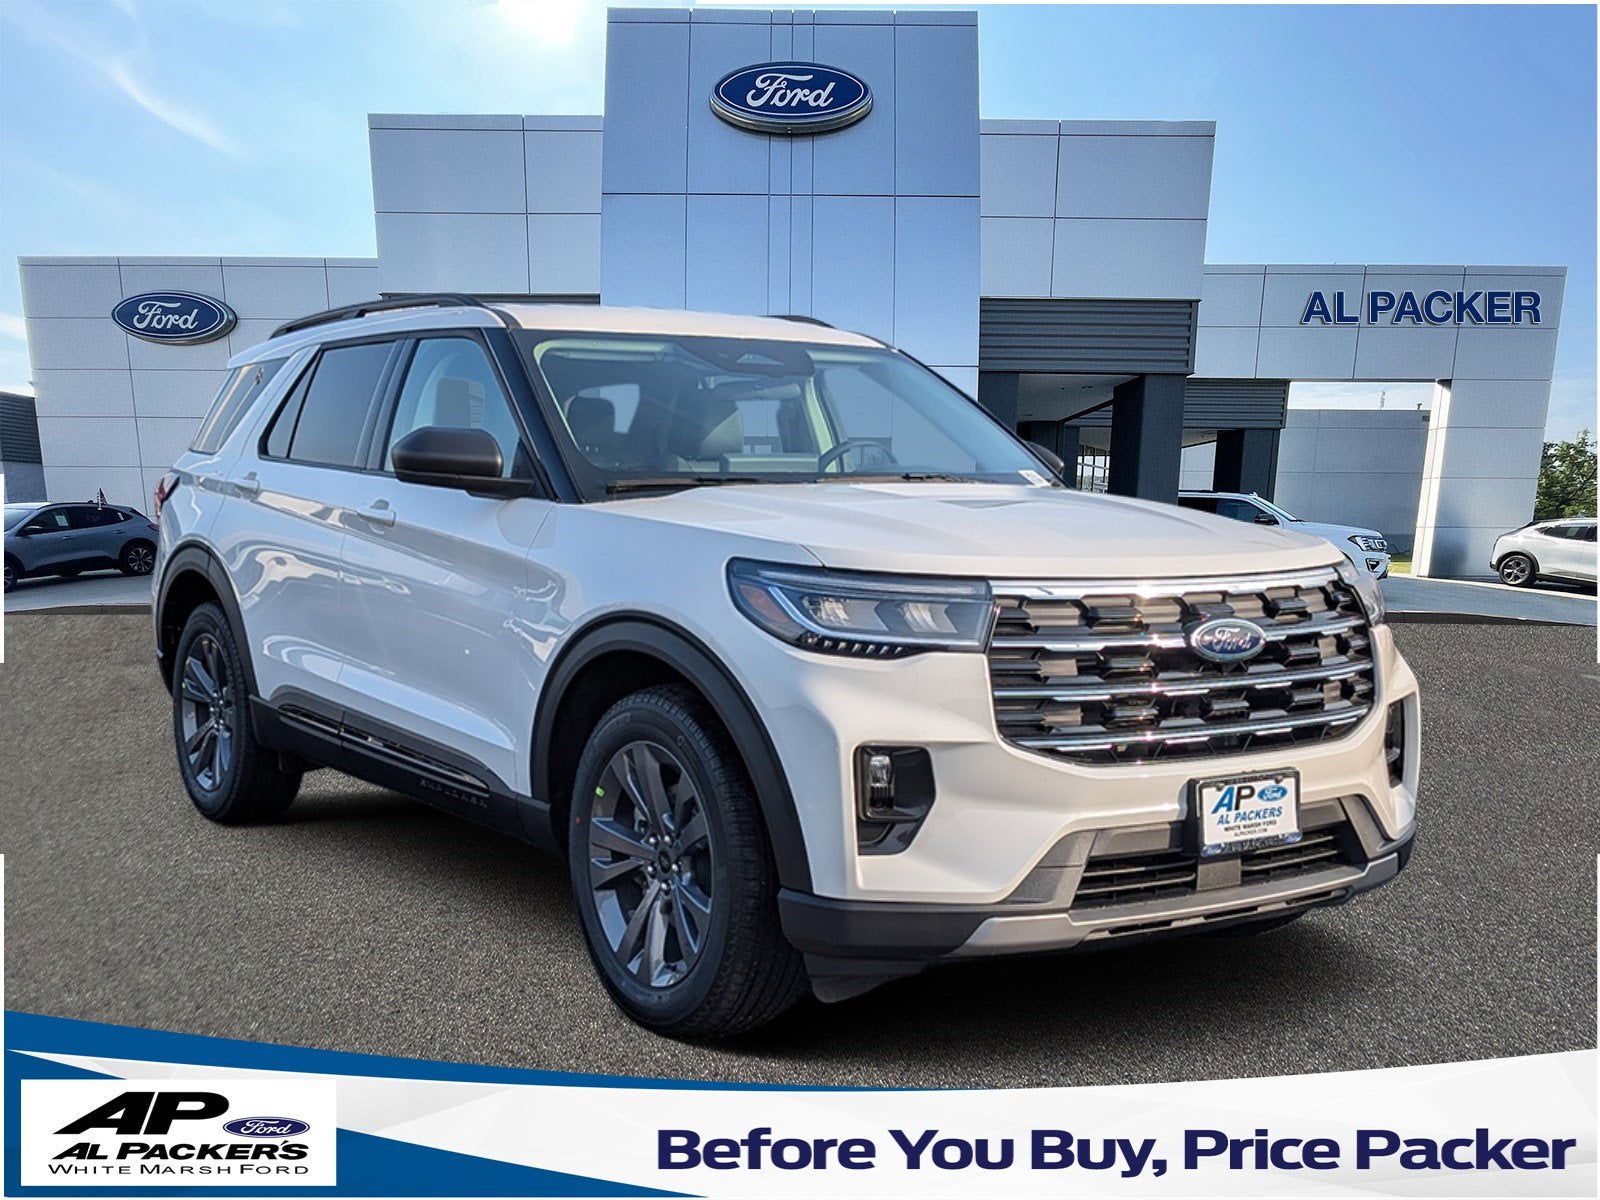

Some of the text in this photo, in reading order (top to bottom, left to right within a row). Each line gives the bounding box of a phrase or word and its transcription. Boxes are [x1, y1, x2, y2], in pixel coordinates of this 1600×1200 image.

[746, 73, 836, 107] Ford
[133, 301, 198, 329] Ford
[1302, 289, 1542, 325] AL PACKER
[1212, 627, 1252, 651] Ford
[1211, 785, 1255, 814] AP
[1217, 806, 1283, 825] AL PACKERS
